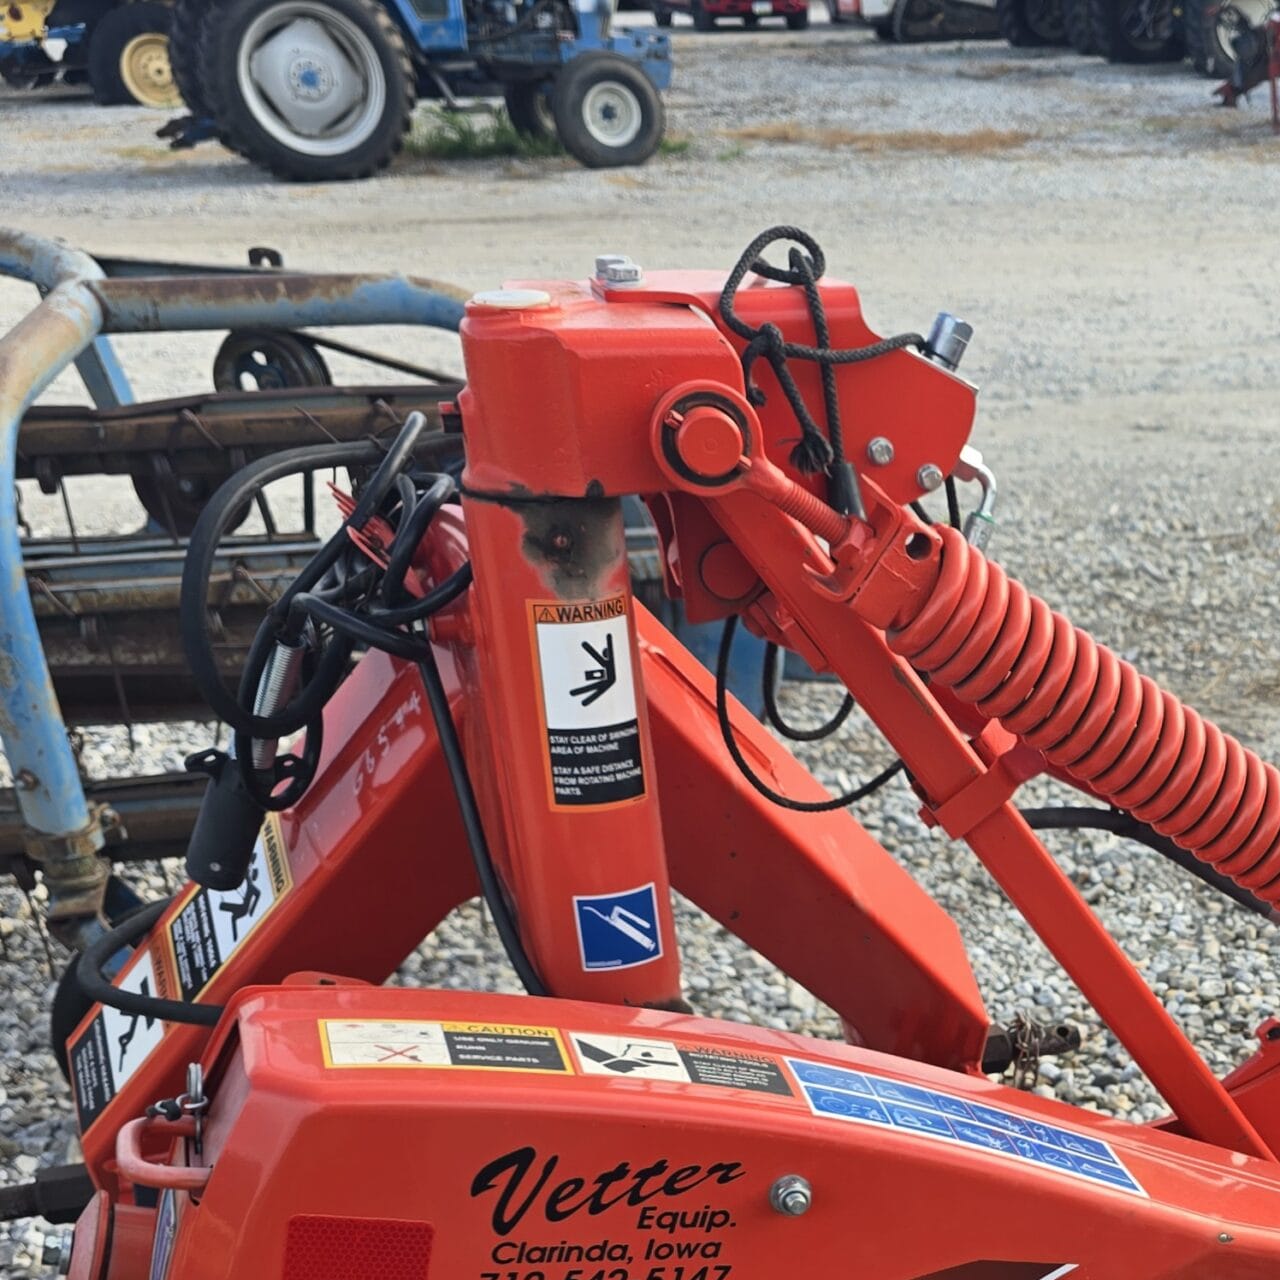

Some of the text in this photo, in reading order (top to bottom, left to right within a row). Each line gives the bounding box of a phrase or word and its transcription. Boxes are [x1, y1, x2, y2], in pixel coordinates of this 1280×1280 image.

[556, 599, 624, 622] WARNING
[550, 736, 568, 744] STAY
[570, 734, 597, 744] CLEAR
[598, 733, 607, 742] OF
[551, 742, 619, 755] AREA OF MACHINE
[553, 766, 571, 775] STAY
[581, 766, 600, 775] SAFE
[554, 777, 576, 785] FROM
[264, 820, 285, 893] WARNING
[467, 1025, 549, 1036] CAUTION
[505, 1055, 540, 1063] PARTS
[695, 1046, 776, 1063] WARNING
[470, 1146, 746, 1236] Vetter
[636, 1206, 737, 1233] Equip.
[491, 1239, 722, 1265] Clarinda, Iowa
